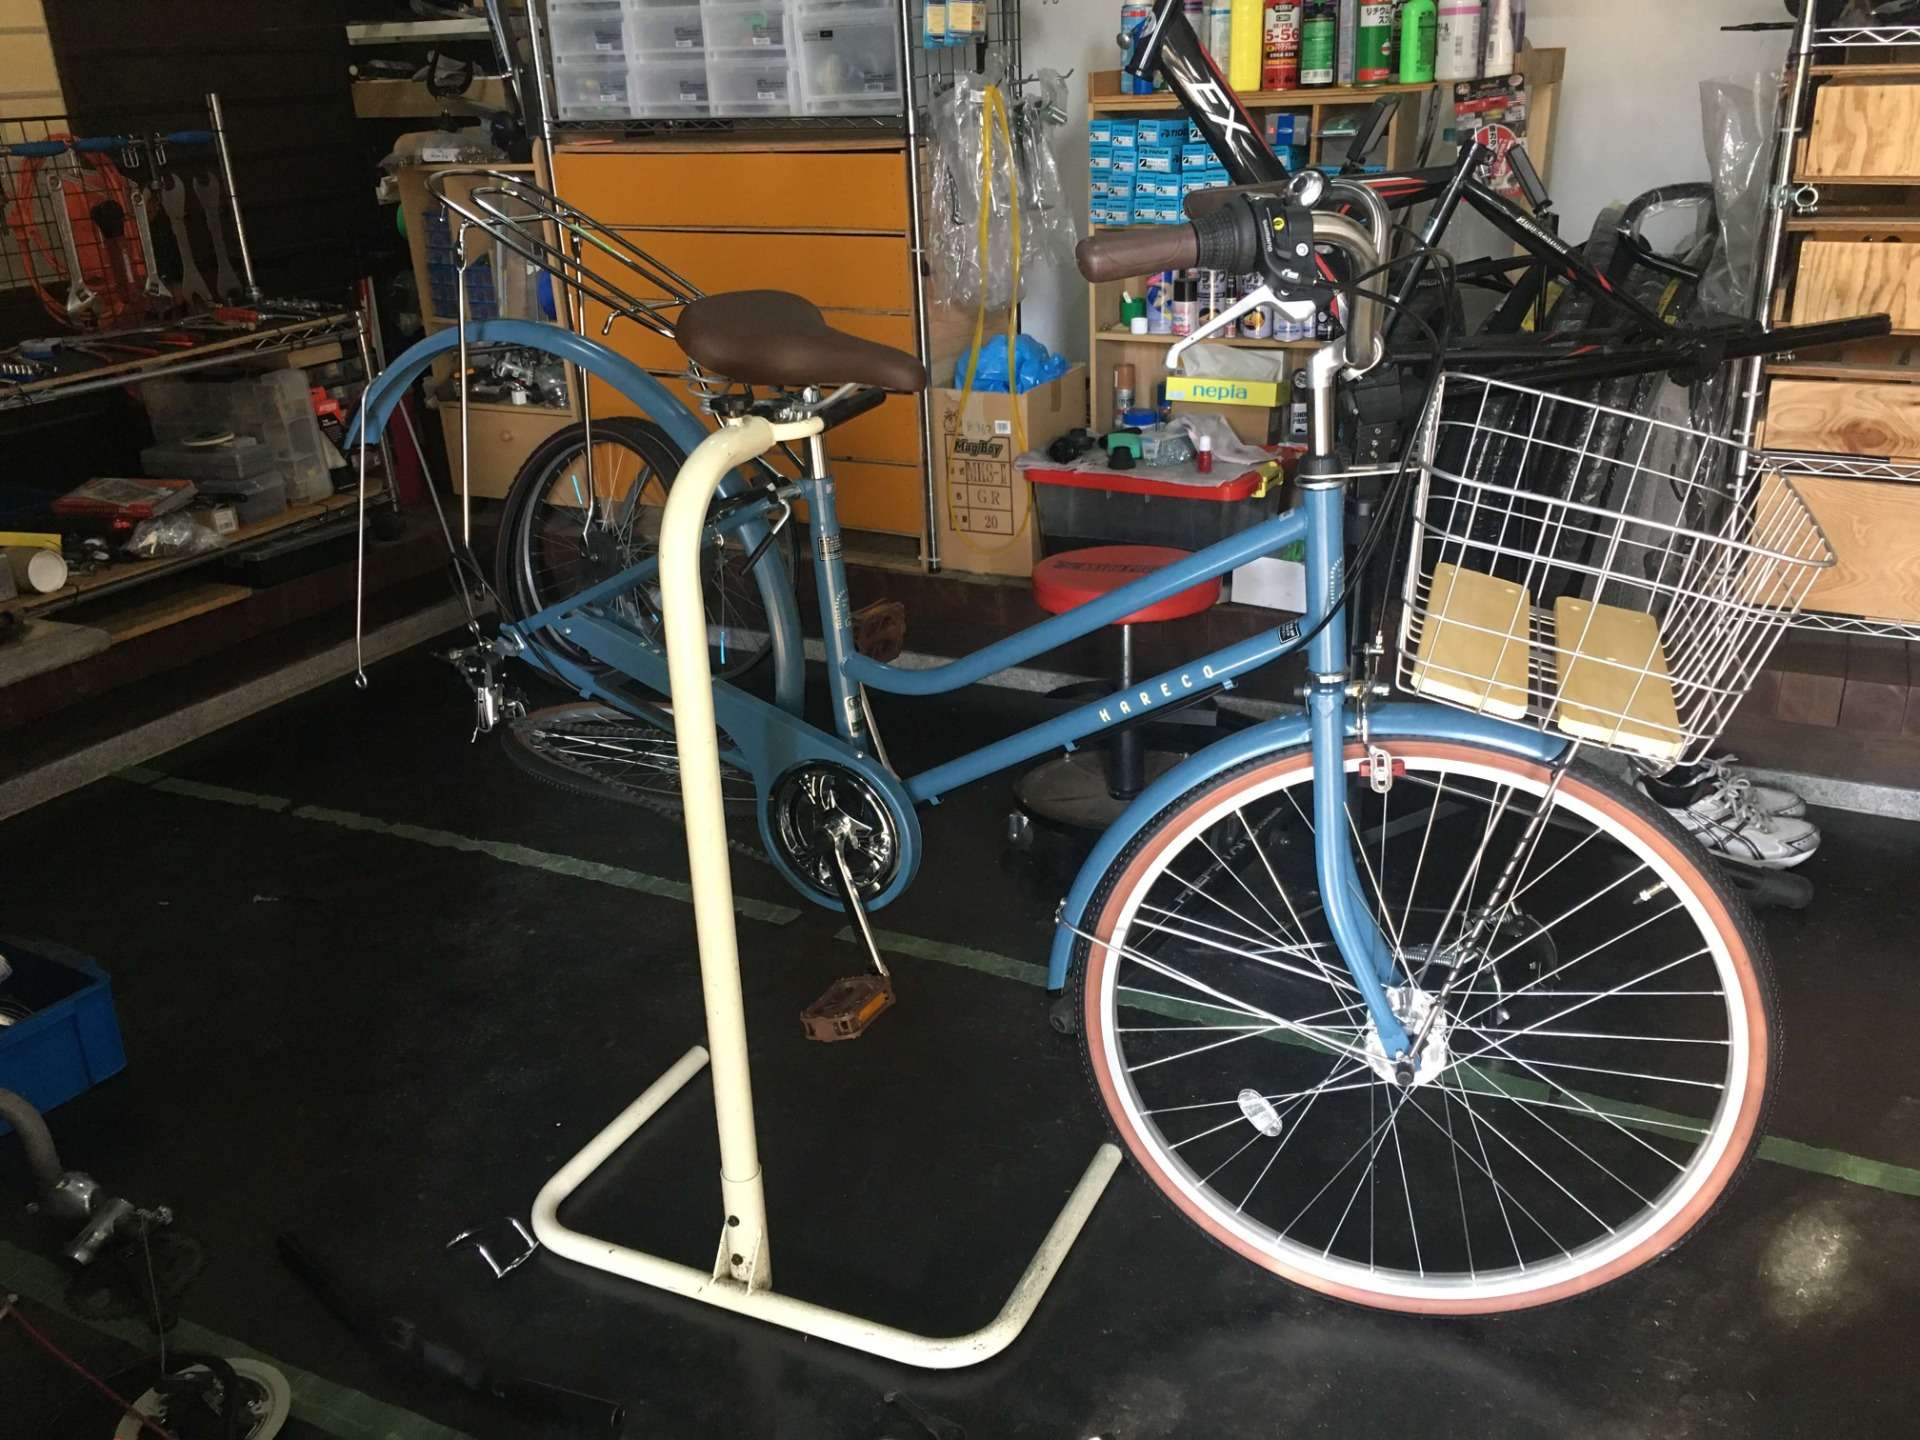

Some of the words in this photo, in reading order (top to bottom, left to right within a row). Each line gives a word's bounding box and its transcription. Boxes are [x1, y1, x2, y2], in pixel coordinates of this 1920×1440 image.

[1266, 28, 1299, 41] 5-56
[1186, 77, 1251, 142] EX
[1192, 384, 1248, 401] nepia
[985, 514, 999, 529] 20
[1099, 665, 1216, 723] HARECO
